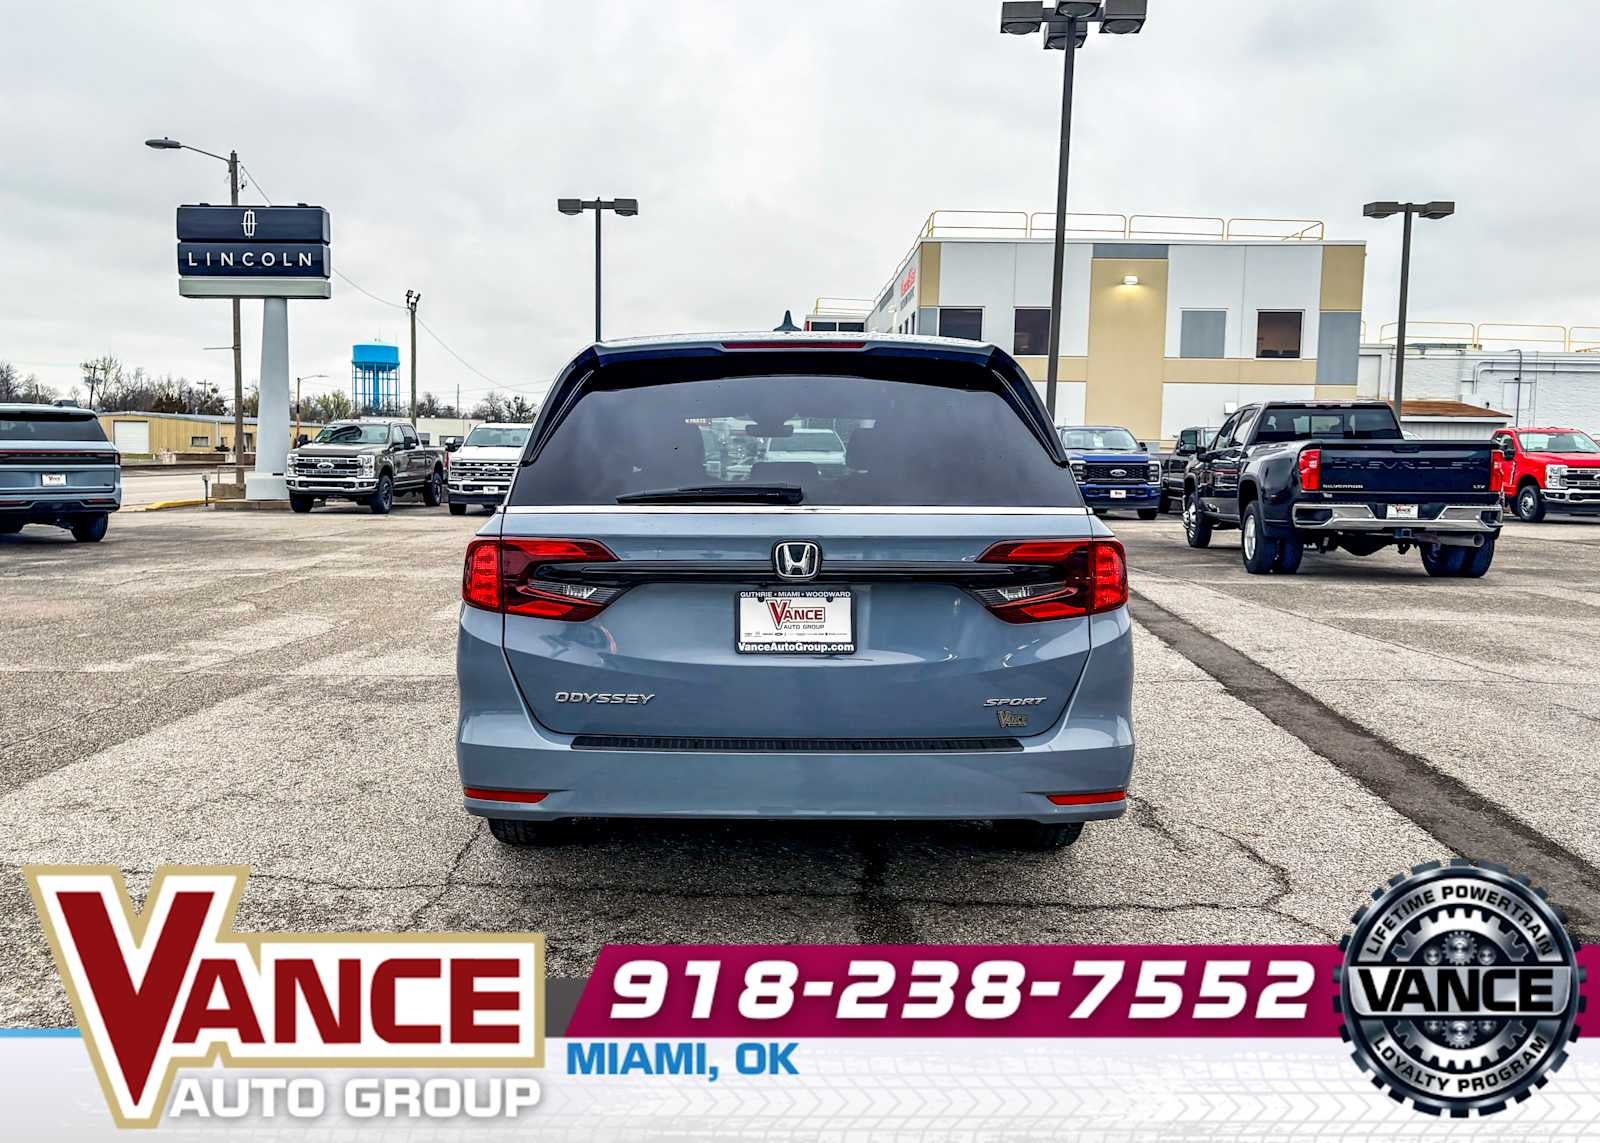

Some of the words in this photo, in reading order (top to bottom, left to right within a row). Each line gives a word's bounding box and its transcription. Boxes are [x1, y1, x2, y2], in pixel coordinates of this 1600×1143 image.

[187, 251, 313, 267] LINCOLN
[769, 602, 824, 627] VANCE
[738, 642, 855, 653] VanceAutoGroup.com
[554, 691, 656, 705] ODYSSEY
[983, 697, 1048, 707] SPORT
